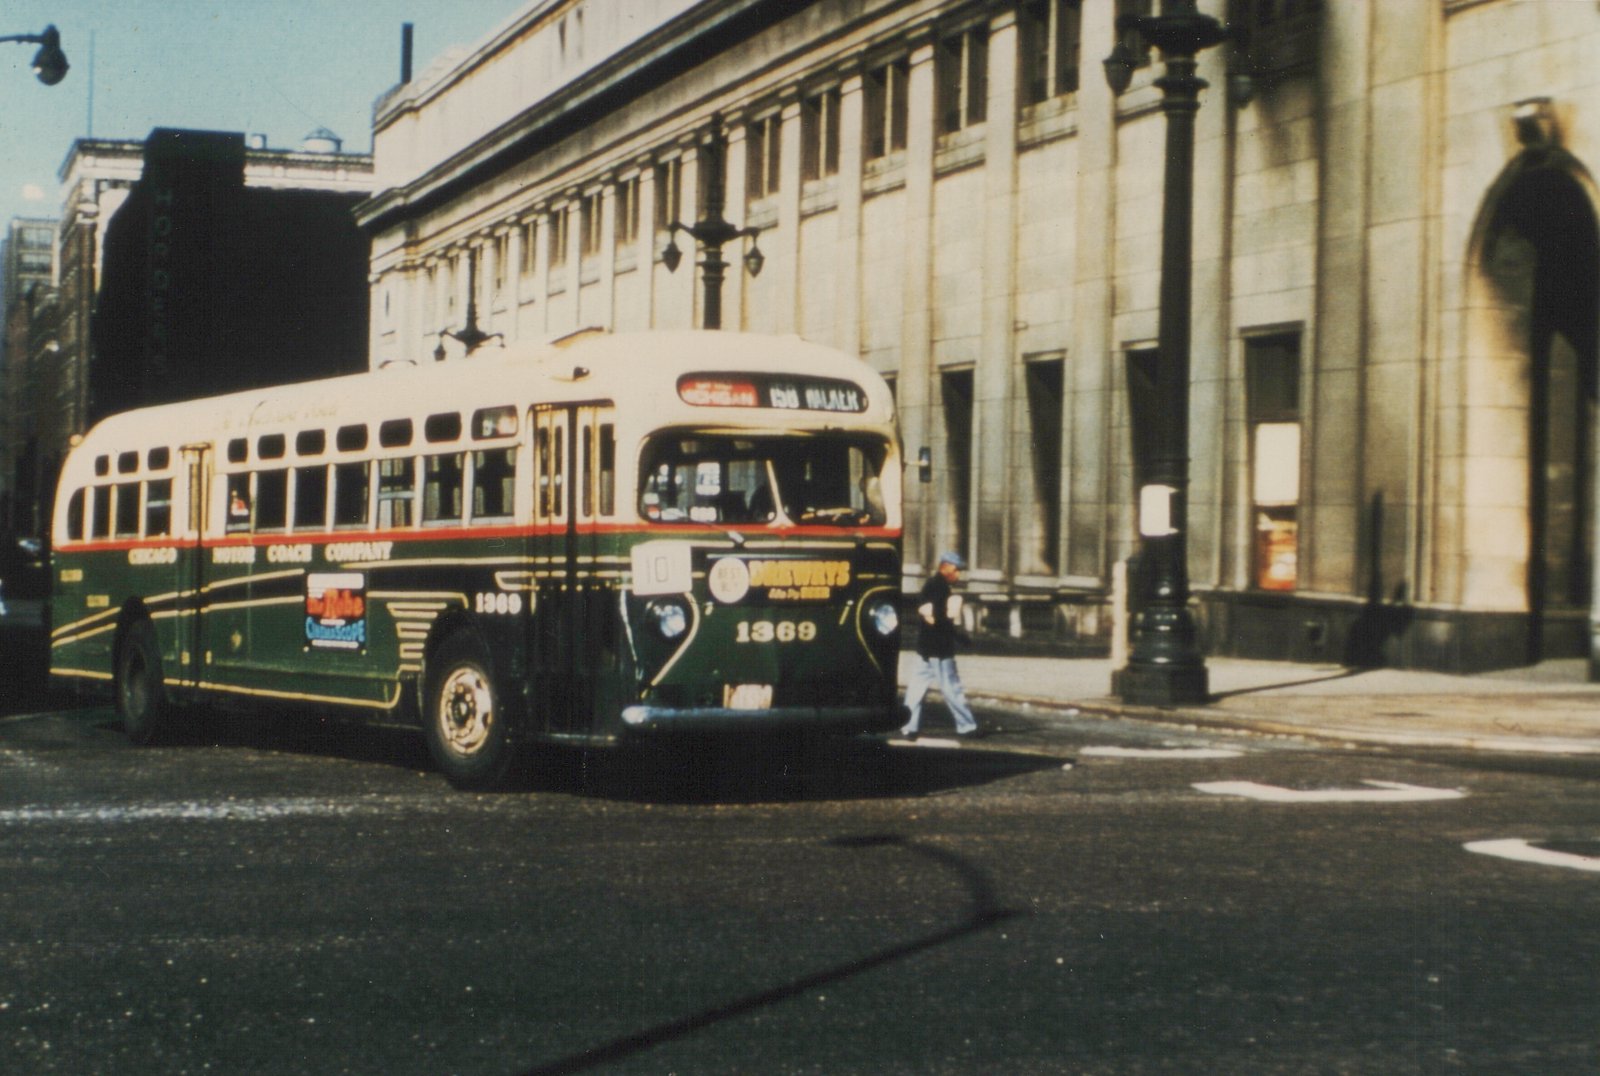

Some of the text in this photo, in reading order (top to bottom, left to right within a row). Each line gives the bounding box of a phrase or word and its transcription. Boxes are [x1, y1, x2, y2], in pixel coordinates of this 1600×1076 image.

[128, 541, 393, 565] CHICAGO MOTOR COACH COMPANY
[735, 620, 817, 643] 1369
